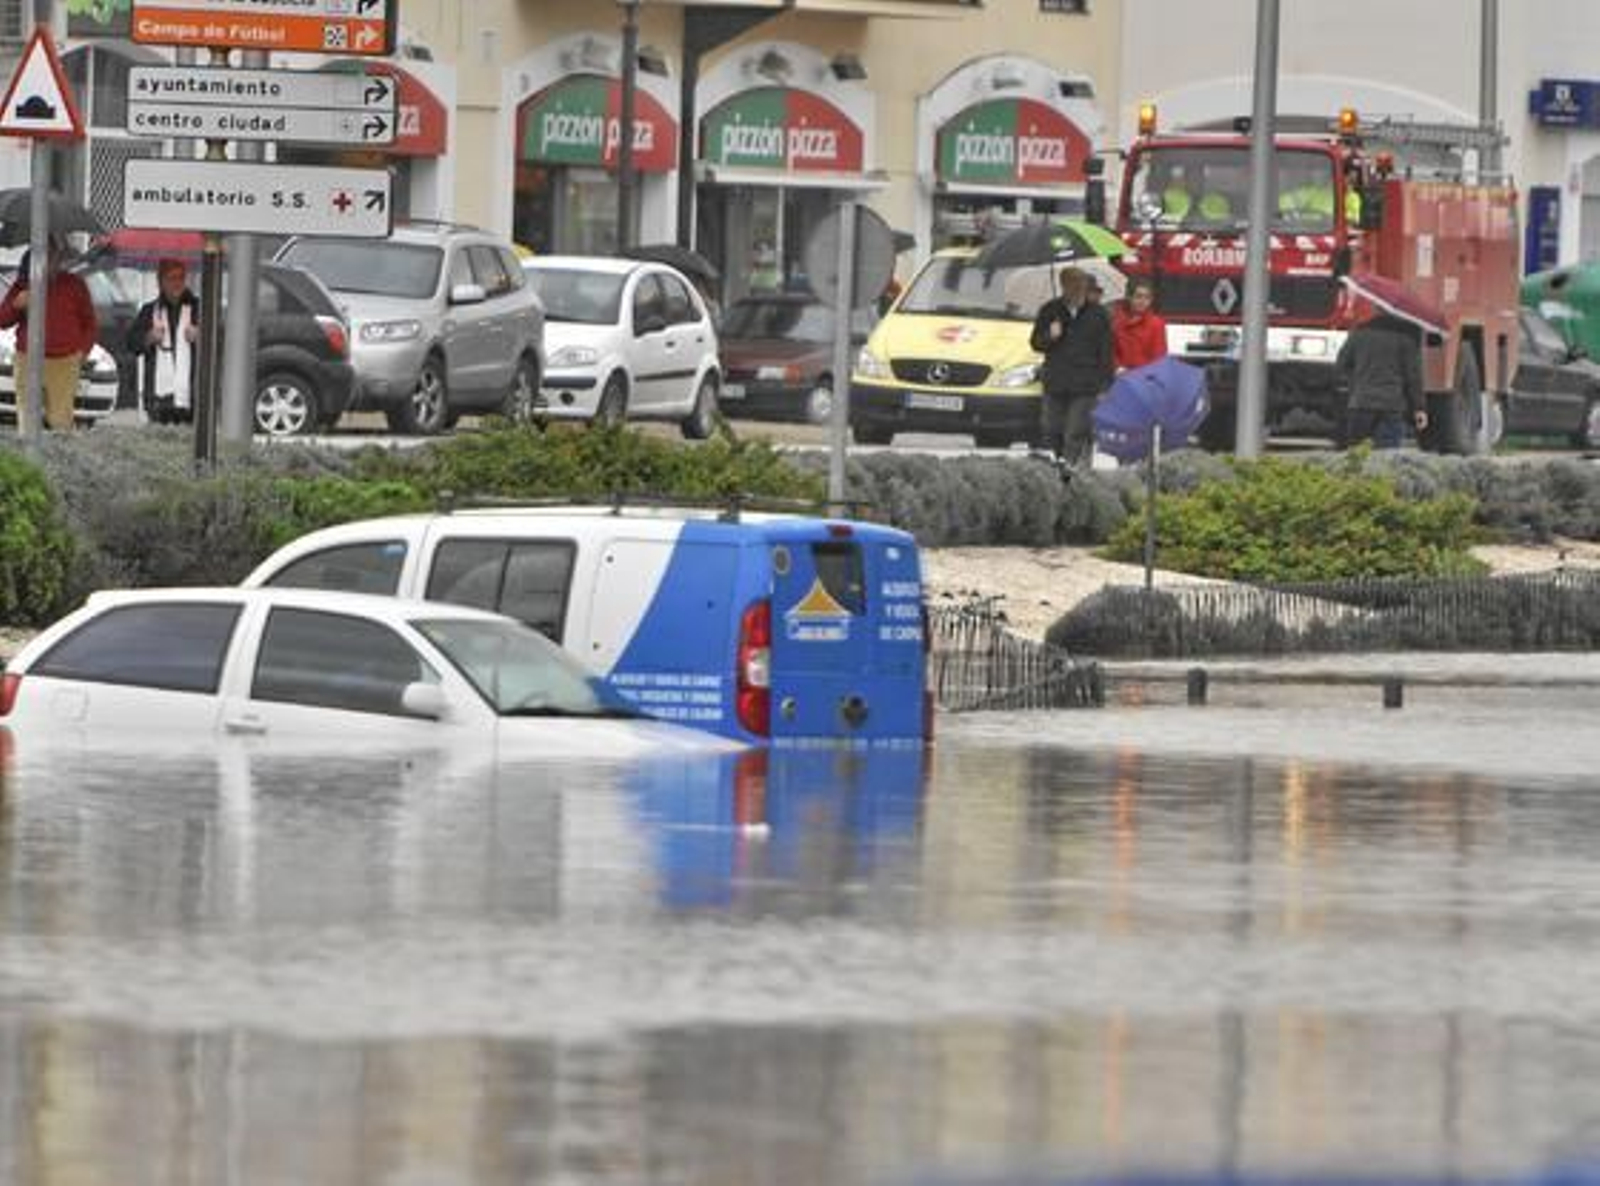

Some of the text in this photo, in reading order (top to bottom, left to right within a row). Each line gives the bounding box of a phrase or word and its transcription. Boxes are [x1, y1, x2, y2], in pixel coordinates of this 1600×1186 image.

[138, 20, 199, 41] Campo
[203, 22, 227, 39] de
[136, 77, 281, 96] ayuntamiento
[135, 113, 286, 131] centro ciudad
[786, 116, 837, 170] pizza
[1018, 122, 1067, 178] pizza
[132, 188, 311, 208] ambulatorio S.S.
